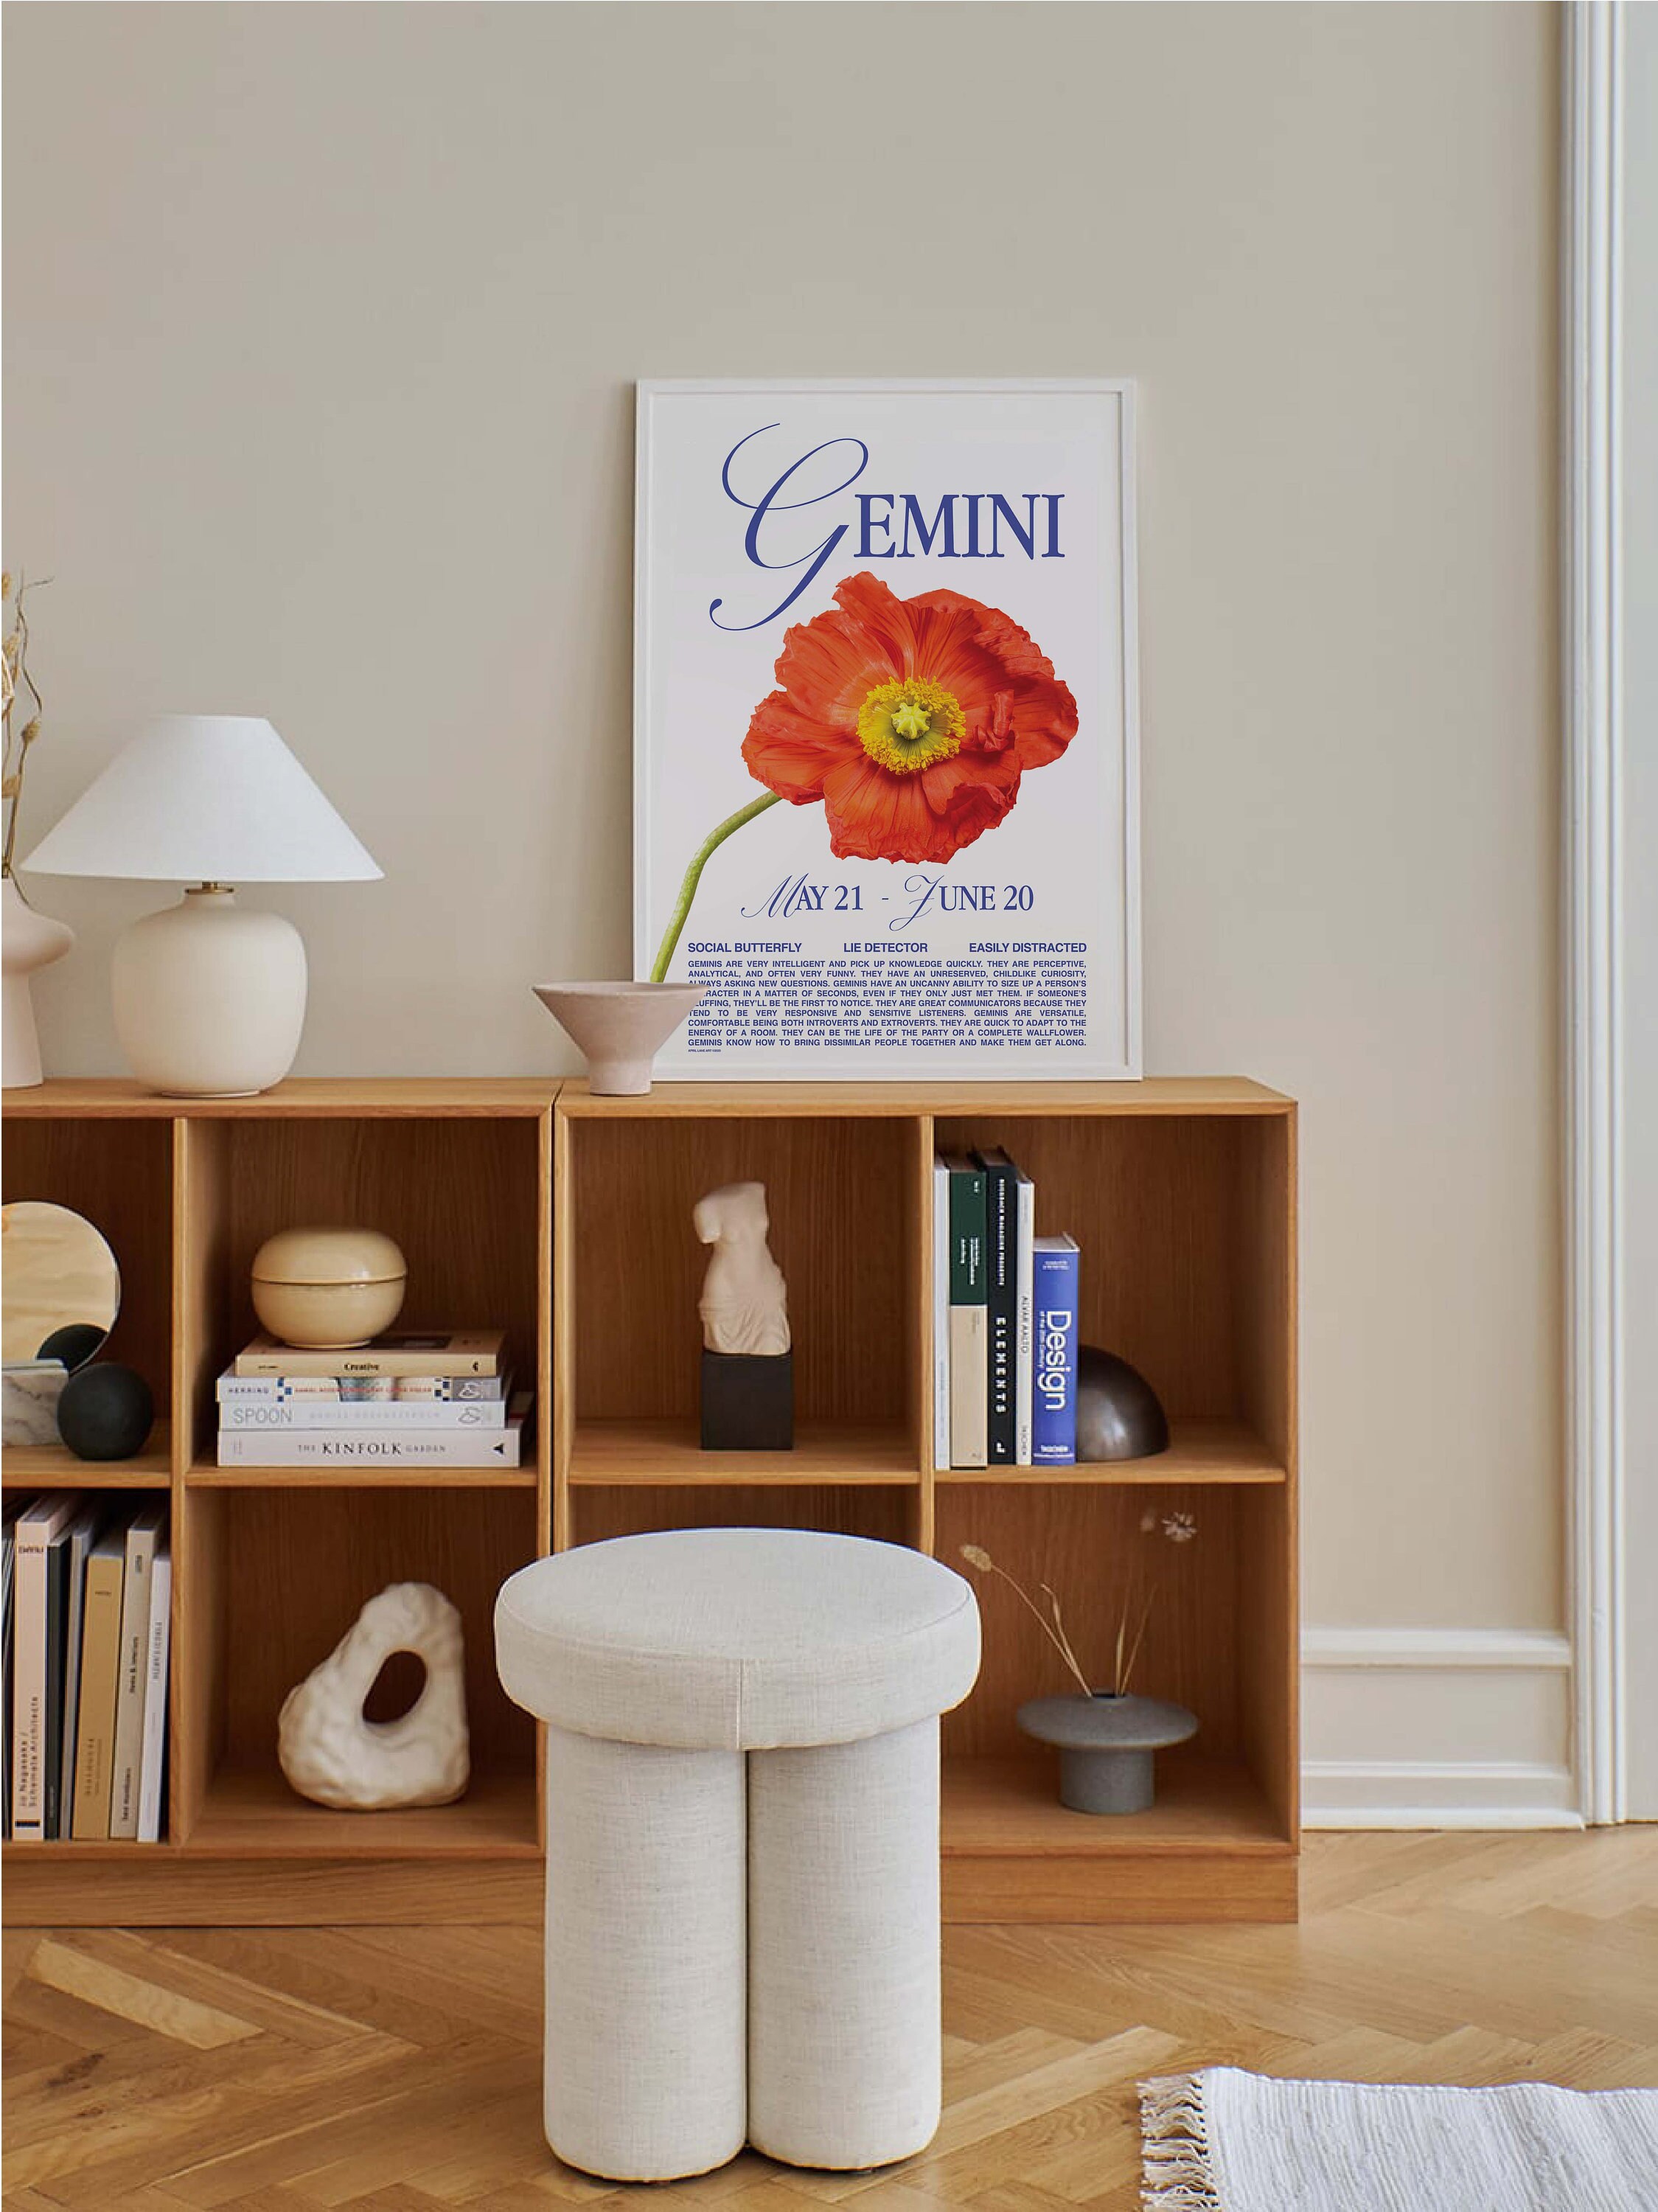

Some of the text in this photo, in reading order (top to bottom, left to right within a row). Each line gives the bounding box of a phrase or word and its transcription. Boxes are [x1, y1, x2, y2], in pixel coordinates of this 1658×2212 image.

[708, 423, 1066, 631] GEMINI
[741, 872, 829, 919] MAY
[834, 885, 864, 911] 21
[889, 874, 997, 932] JUNE
[1003, 885, 1034, 911] 20
[688, 942, 801, 953] SOCIAL BUTTERFLY
[844, 942, 927, 953] LIE DETECTOR
[969, 942, 1087, 953] EASILY DISTRACTED
[1033, 960, 1086, 969] PERCEPTIVE,
[688, 970, 1086, 979] ANALYTICAL, AND OFTEN VERY FUNNY. THEY HAVE AN UNRESERVED, CHILDLIKE CURIOSITY,
[816, 990, 858, 998] SECONDS,
[695, 999, 731, 1009] UFFING,
[769, 999, 780, 1007] BE
[782, 999, 798, 1007] THE
[801, 999, 825, 1007] FIRST
[826, 999, 838, 1007] TO
[840, 999, 873, 1007] NOTICE.
[875, 999, 896, 1007] THEY
[899, 999, 916, 1007] ARE
[918, 999, 946, 1007] GREAT
[948, 999, 1020, 1007] COMMUNICATORS
[1023, 999, 1062, 1007] BECAUSE
[1065, 999, 1086, 1007] THEY
[1039, 1009, 1086, 1018] VERSATILE,
[688, 1029, 1086, 1037] ENERGY OF A ROOM. THEY CAN BE THE LIFE OF THE PARTY OR A COMPLETE WALLFLOWER.
[995, 1317, 1007, 1413] ELEMENTS
[1037, 1310, 1072, 1411] Design
[233, 1408, 293, 1425] SPOON
[297, 1444, 316, 1453] THE
[321, 1443, 403, 1455] KINFOLK
